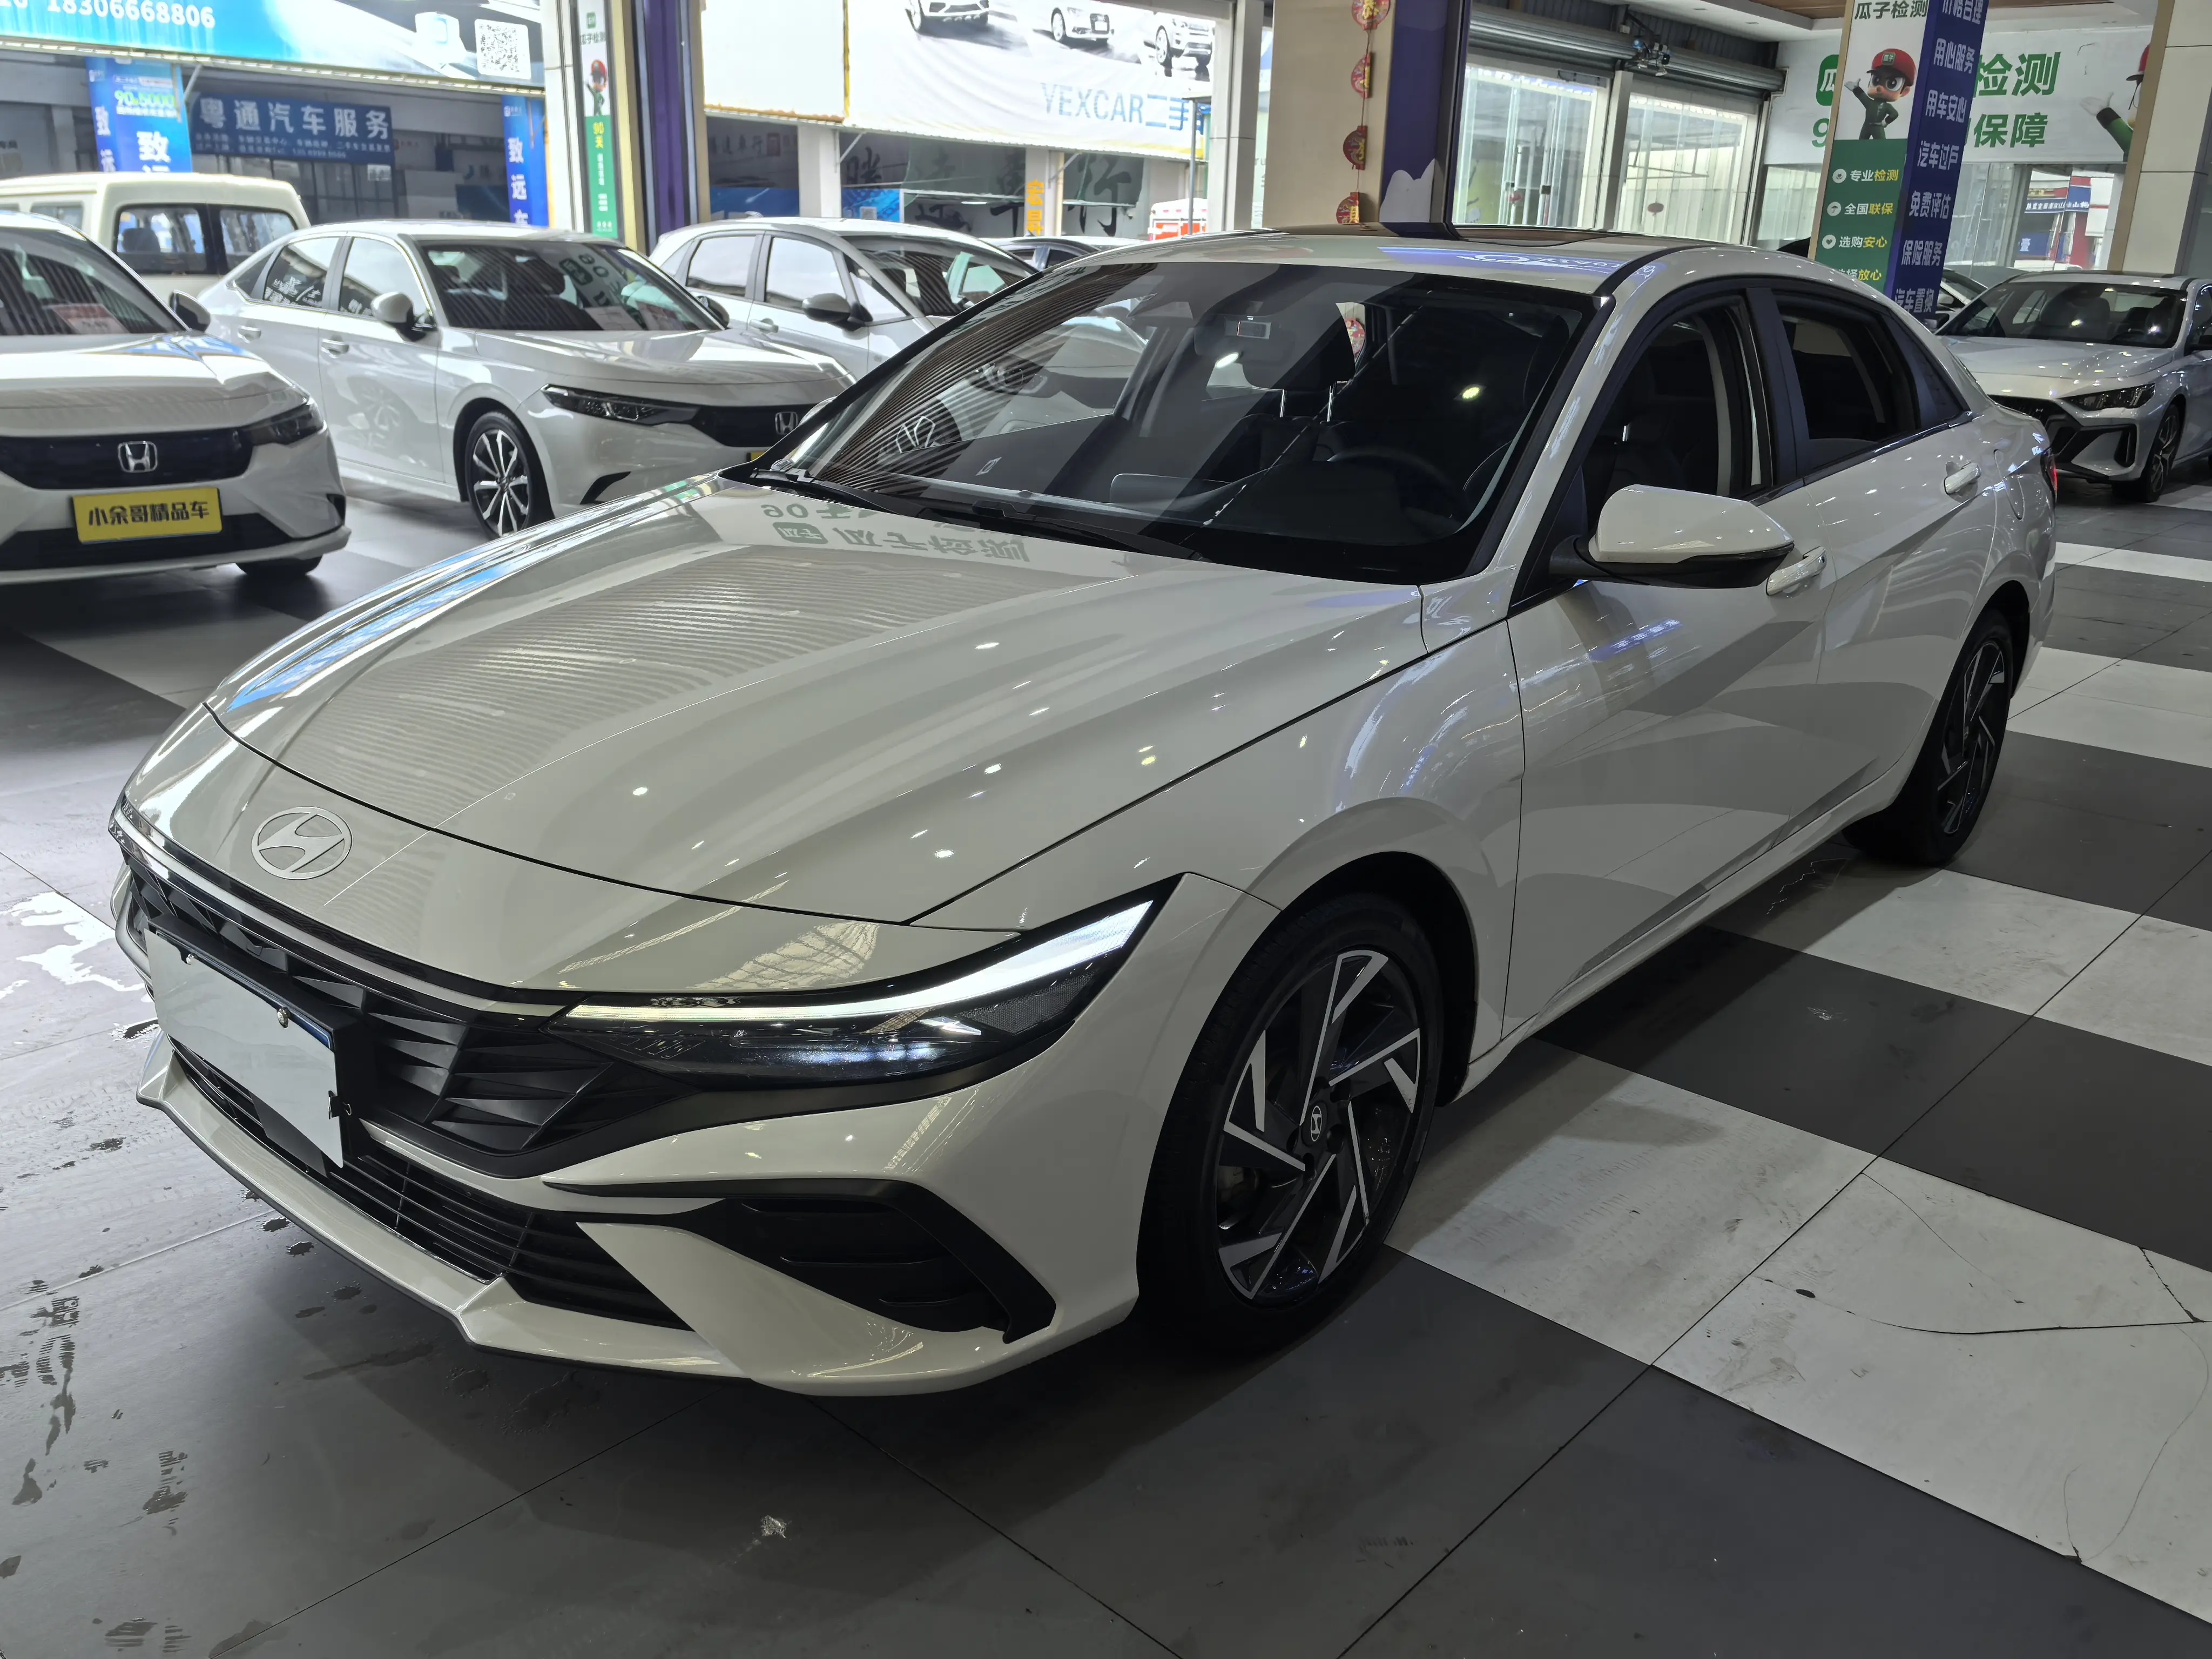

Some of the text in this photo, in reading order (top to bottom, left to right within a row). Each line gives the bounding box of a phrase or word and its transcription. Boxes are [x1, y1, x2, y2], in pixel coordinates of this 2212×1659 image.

[48, 0, 215, 29] 18306668806
[1854, 0, 1928, 20] 瓜子检测
[1933, 38, 1975, 74] 用心服务
[1974, 51, 2061, 98] 检测
[200, 97, 389, 140] 粤通汽车服务
[1925, 89, 1967, 123] 用车安心
[1965, 112, 2048, 148] 保障
[1917, 140, 1960, 171] 汽车过户
[1850, 169, 1899, 182] 专业检测
[1844, 202, 1893, 215] 全国联保
[1909, 191, 1951, 219] 免费评估
[1839, 236, 1887, 248] 选购安心
[1901, 240, 1943, 267] 保险服务
[1894, 288, 1934, 313] 汽车置换
